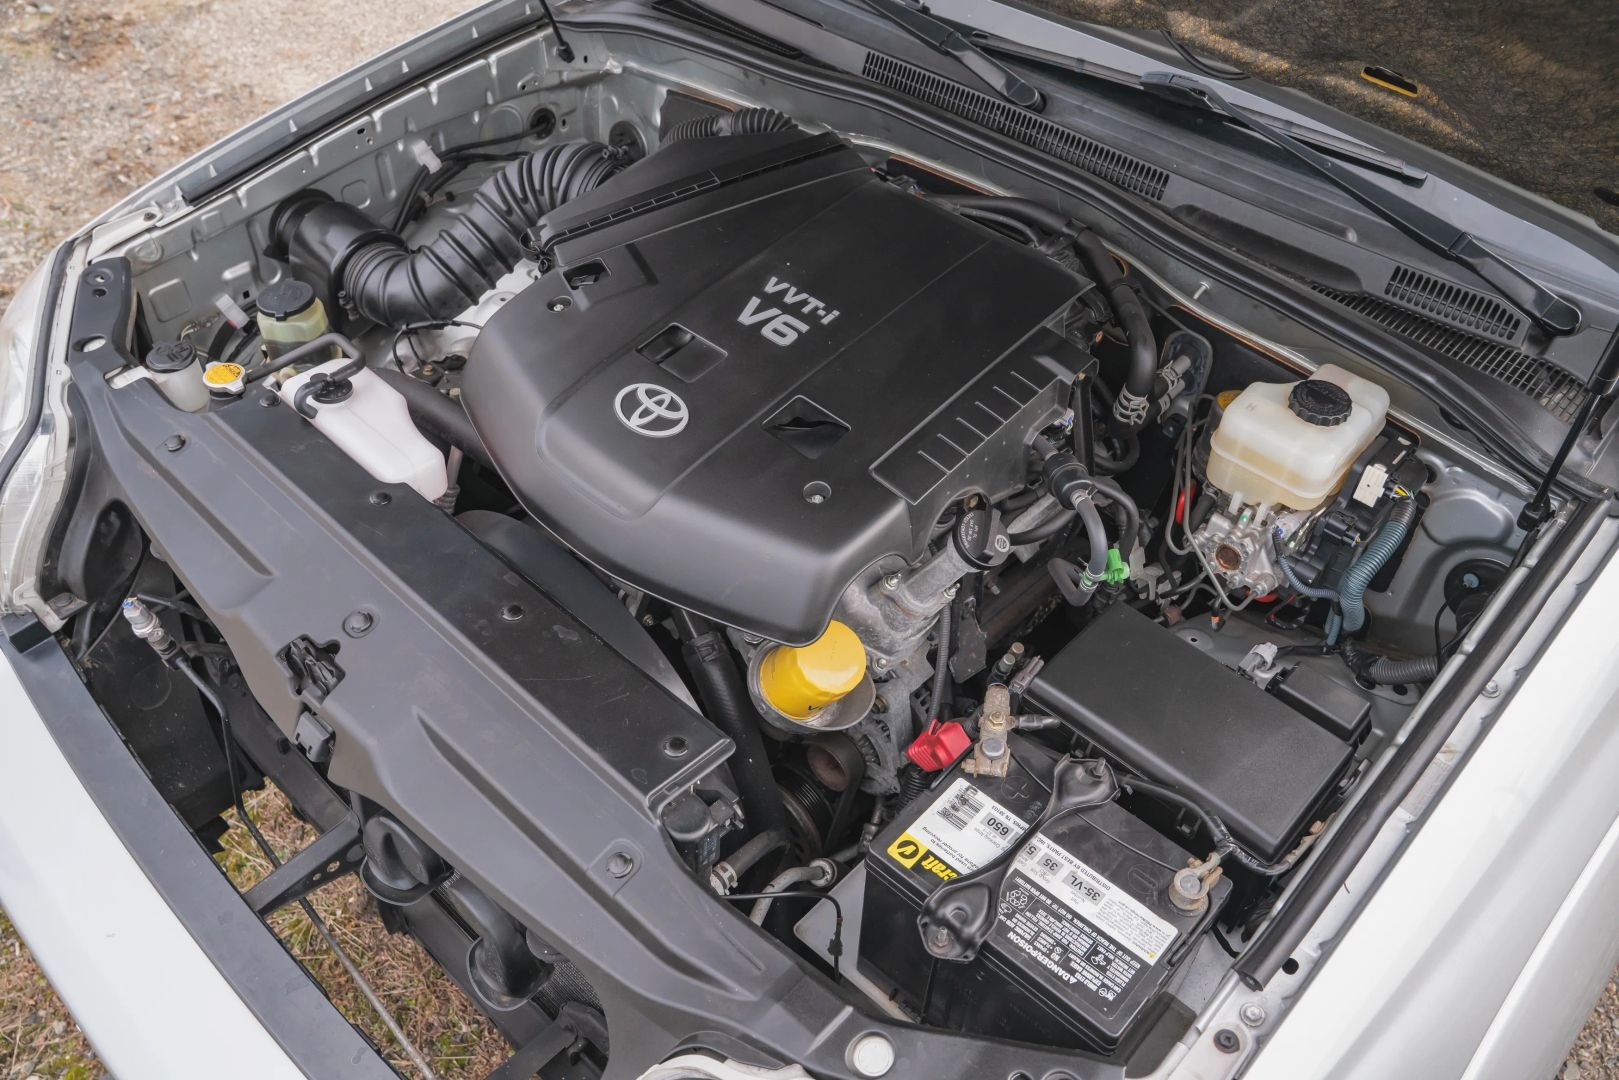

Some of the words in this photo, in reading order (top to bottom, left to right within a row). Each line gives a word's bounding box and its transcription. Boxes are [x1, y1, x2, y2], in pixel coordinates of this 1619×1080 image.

[764, 276, 840, 325] VVT-i
[737, 296, 811, 347] V6
[985, 815, 1010, 837] 650
[1042, 856, 1058, 871] 35
[1060, 853, 1074, 865] BEST
[921, 854, 958, 881] craft
[1072, 862, 1081, 870] BY
[1079, 866, 1111, 891] DISTRIBUTED
[1067, 873, 1101, 902] 35-VL
[1095, 934, 1109, 946] REACH
[1107, 943, 1117, 951] THE
[1115, 948, 1123, 956] OF
[1006, 930, 1070, 981] DANGER/POISON
[1050, 951, 1060, 961] NO
[1121, 953, 1131, 962] OUT
[1129, 958, 1140, 969] KEEP
